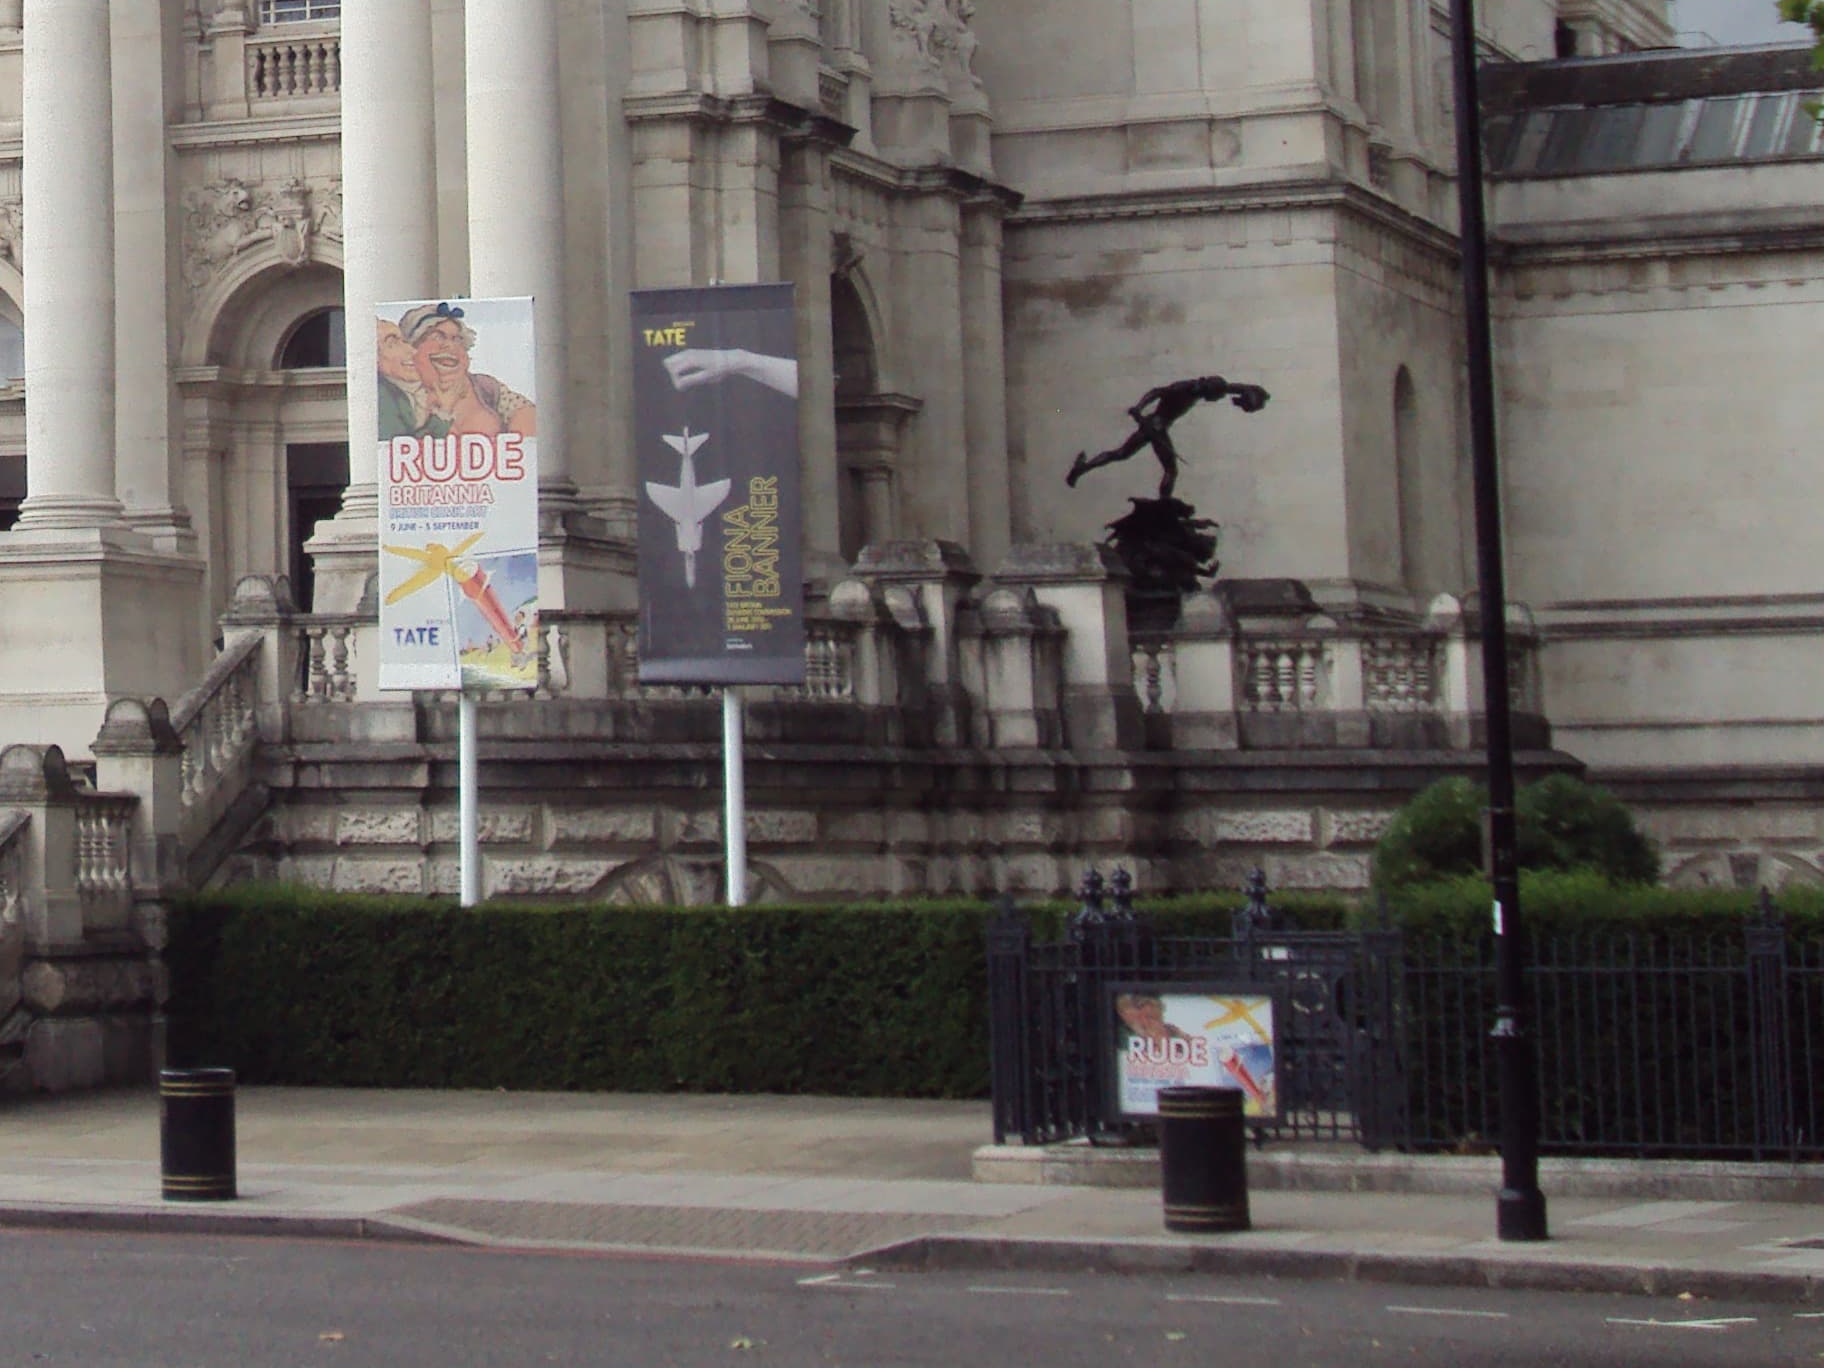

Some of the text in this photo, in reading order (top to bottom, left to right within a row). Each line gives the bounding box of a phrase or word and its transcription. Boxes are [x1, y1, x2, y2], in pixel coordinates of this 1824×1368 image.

[643, 328, 686, 346] TATE
[389, 431, 525, 483] RUDE
[389, 483, 495, 505] BRITANNIA
[432, 521, 479, 530] SEPTEMBER
[750, 476, 780, 597] BANNER
[724, 504, 753, 597] FIONA
[393, 627, 440, 646] TATE
[1127, 1035, 1208, 1066] RUDE
